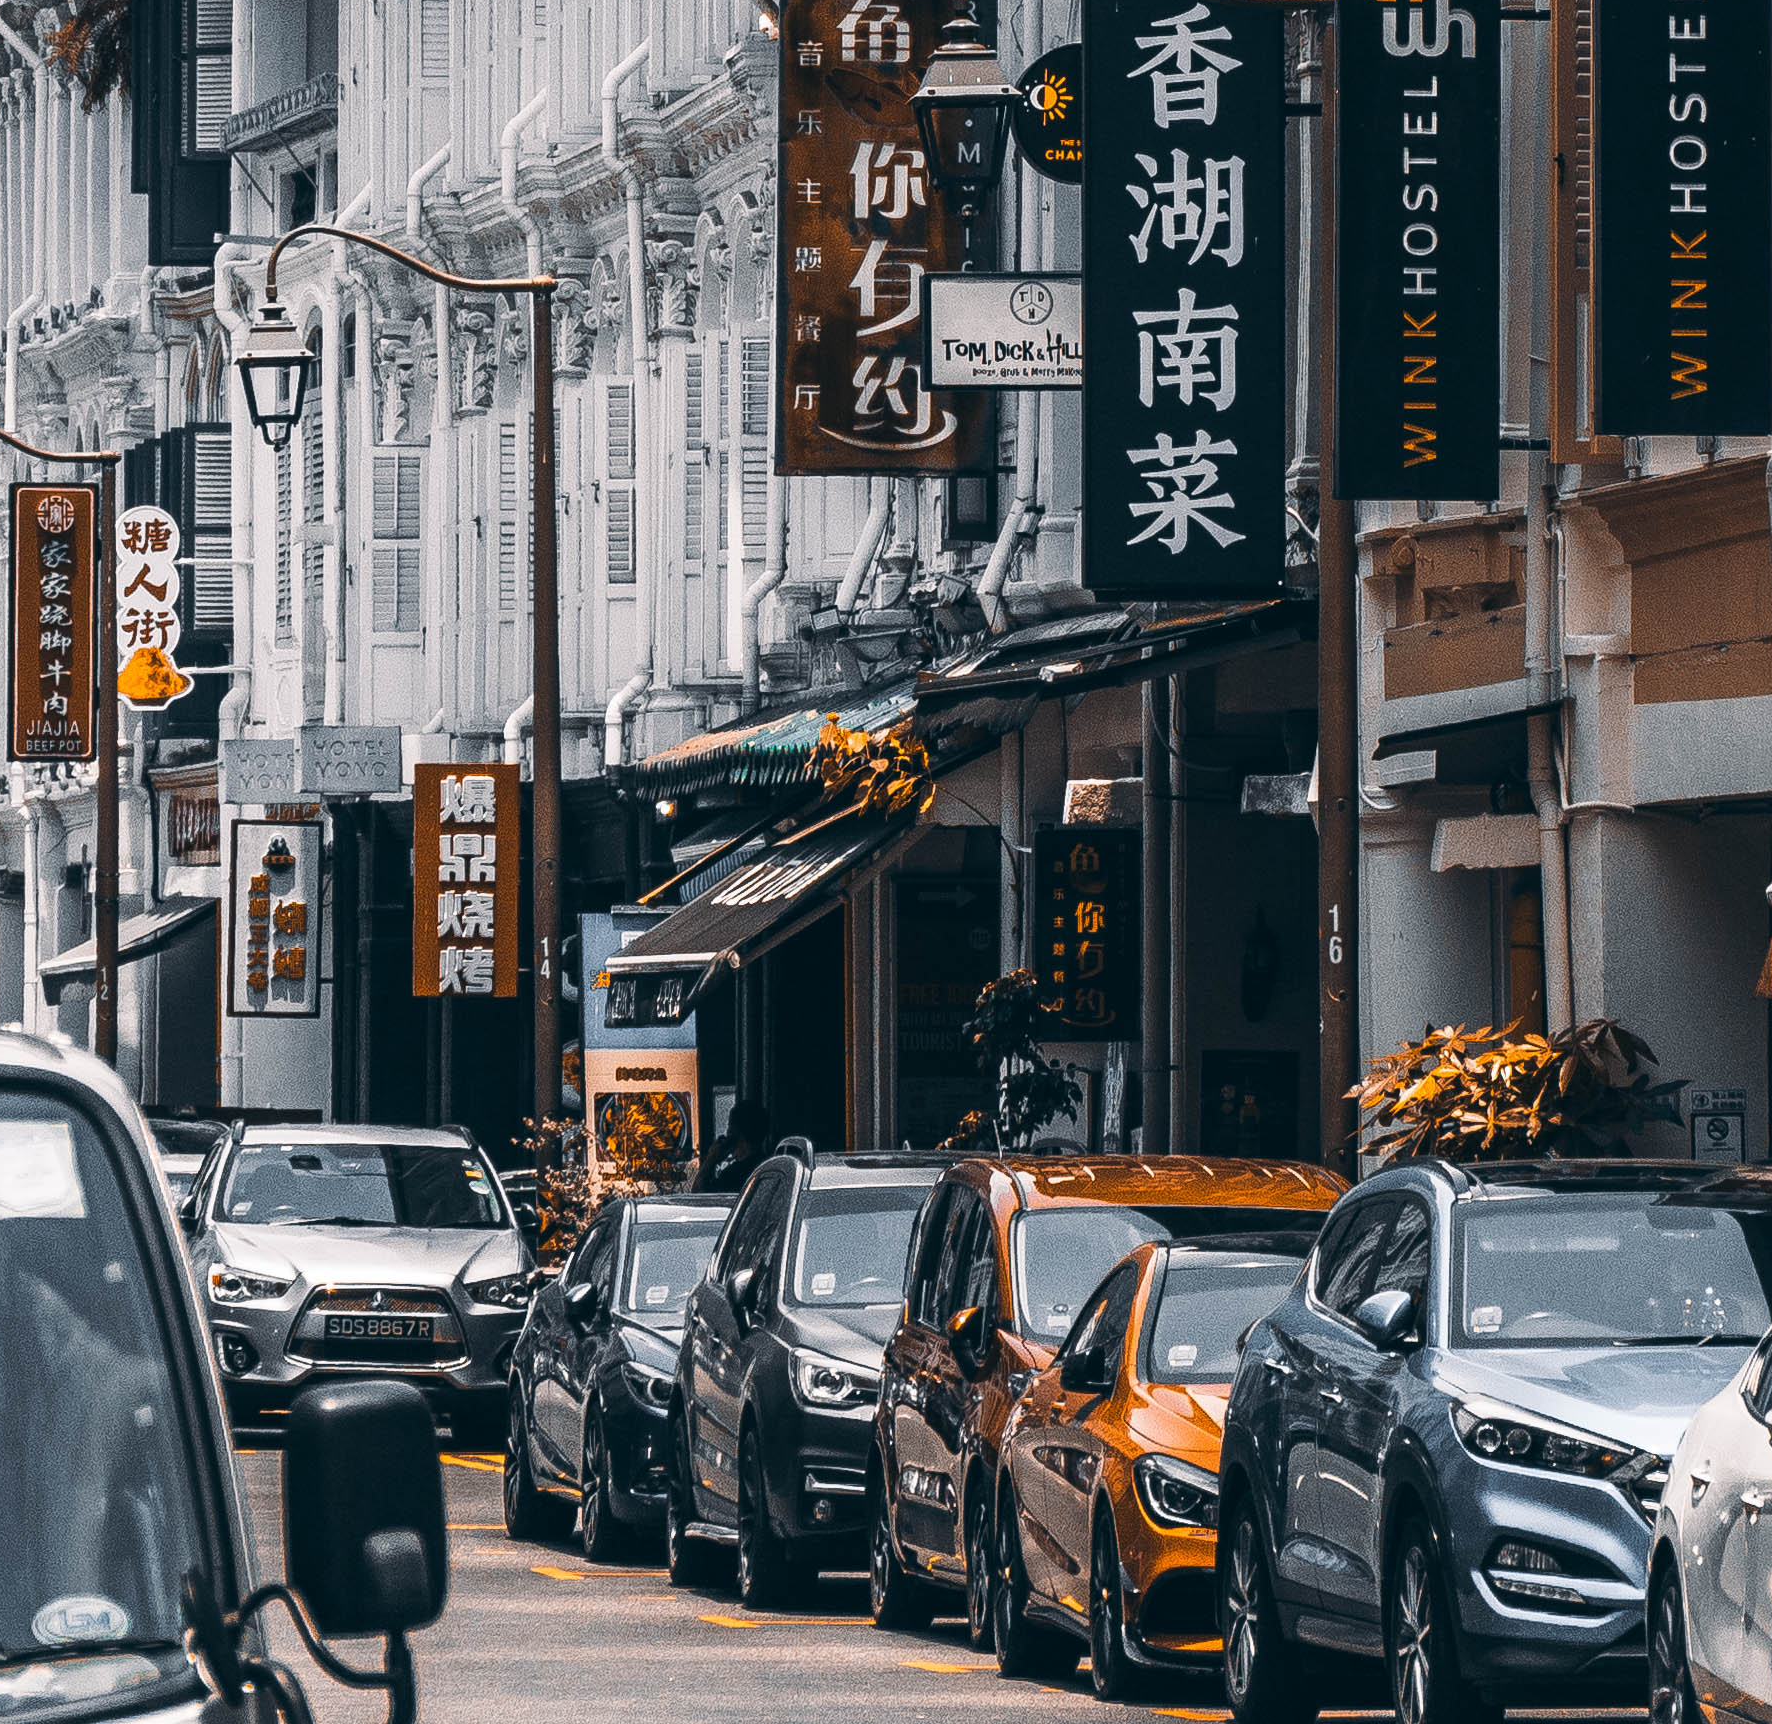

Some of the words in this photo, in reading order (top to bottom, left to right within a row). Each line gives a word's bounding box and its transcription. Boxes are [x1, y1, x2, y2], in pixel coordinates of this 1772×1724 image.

[794, 40, 824, 412] 音乐主题餐厅
[121, 518, 174, 649] 糖人街
[26, 719, 80, 738] JIAJIA
[26, 739, 56, 753] BEEF
[58, 738, 82, 752] POT
[237, 753, 295, 769] HOTE
[240, 773, 290, 789] MON
[1328, 904, 1343, 964] 16
[540, 936, 551, 980] 14
[100, 966, 109, 1001] 12
[329, 1318, 430, 1336] SDS8867R
